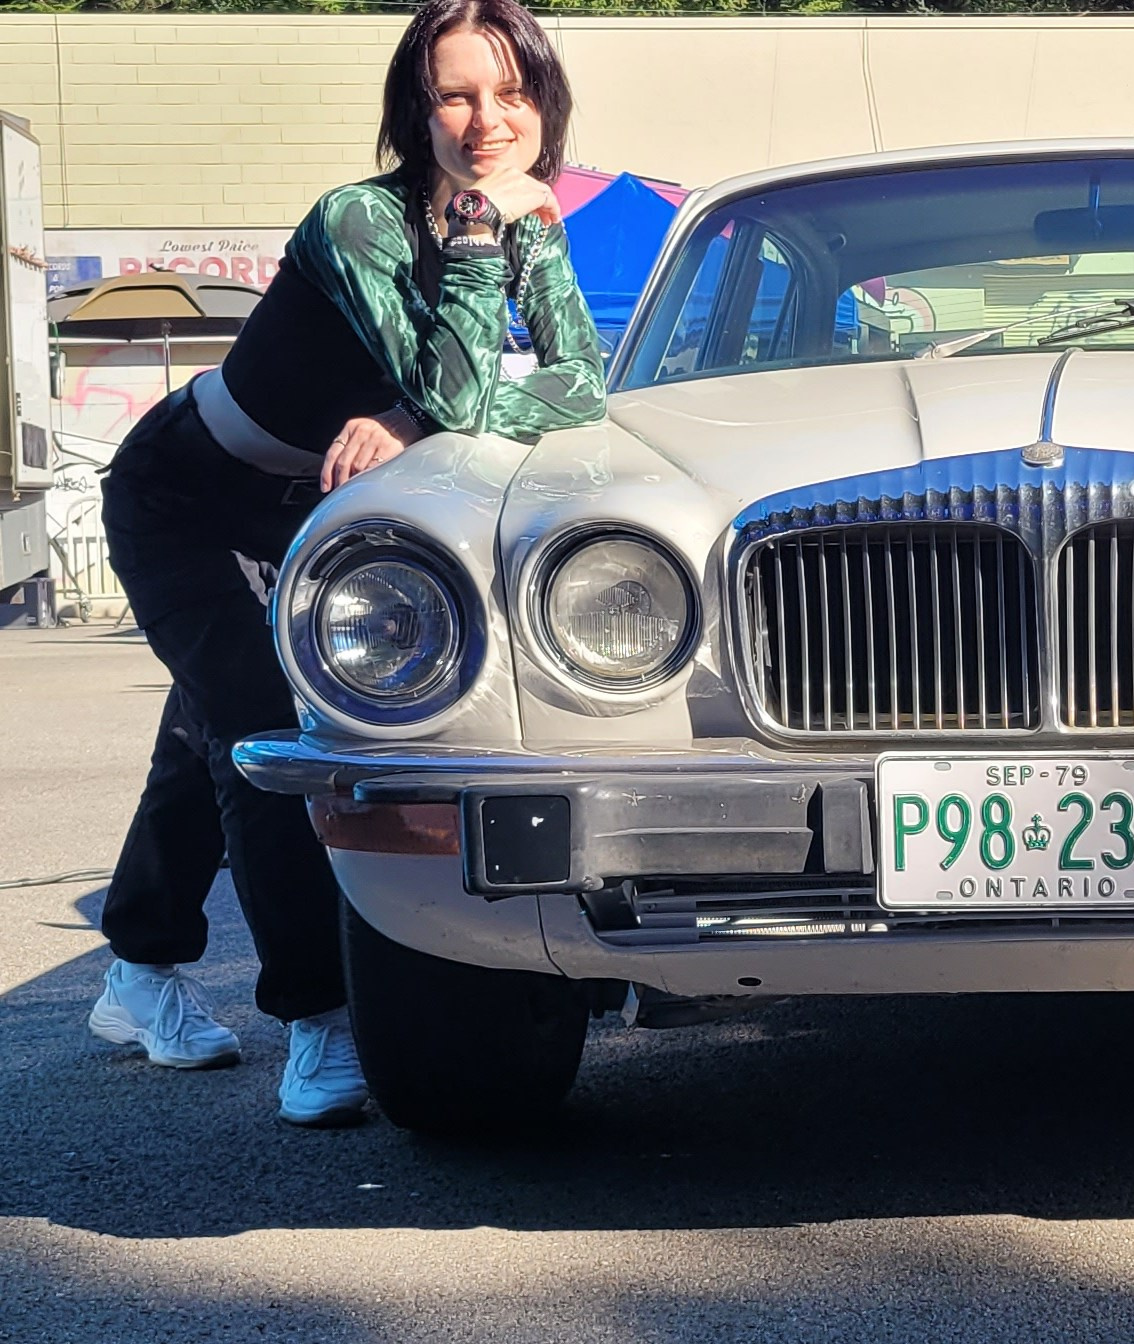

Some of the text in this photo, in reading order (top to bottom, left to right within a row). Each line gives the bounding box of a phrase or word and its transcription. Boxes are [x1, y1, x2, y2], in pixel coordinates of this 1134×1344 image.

[160, 240, 259, 252] Lowest Price
[893, 793, 1016, 872] P98
[959, 877, 1117, 898] ONTARIO
